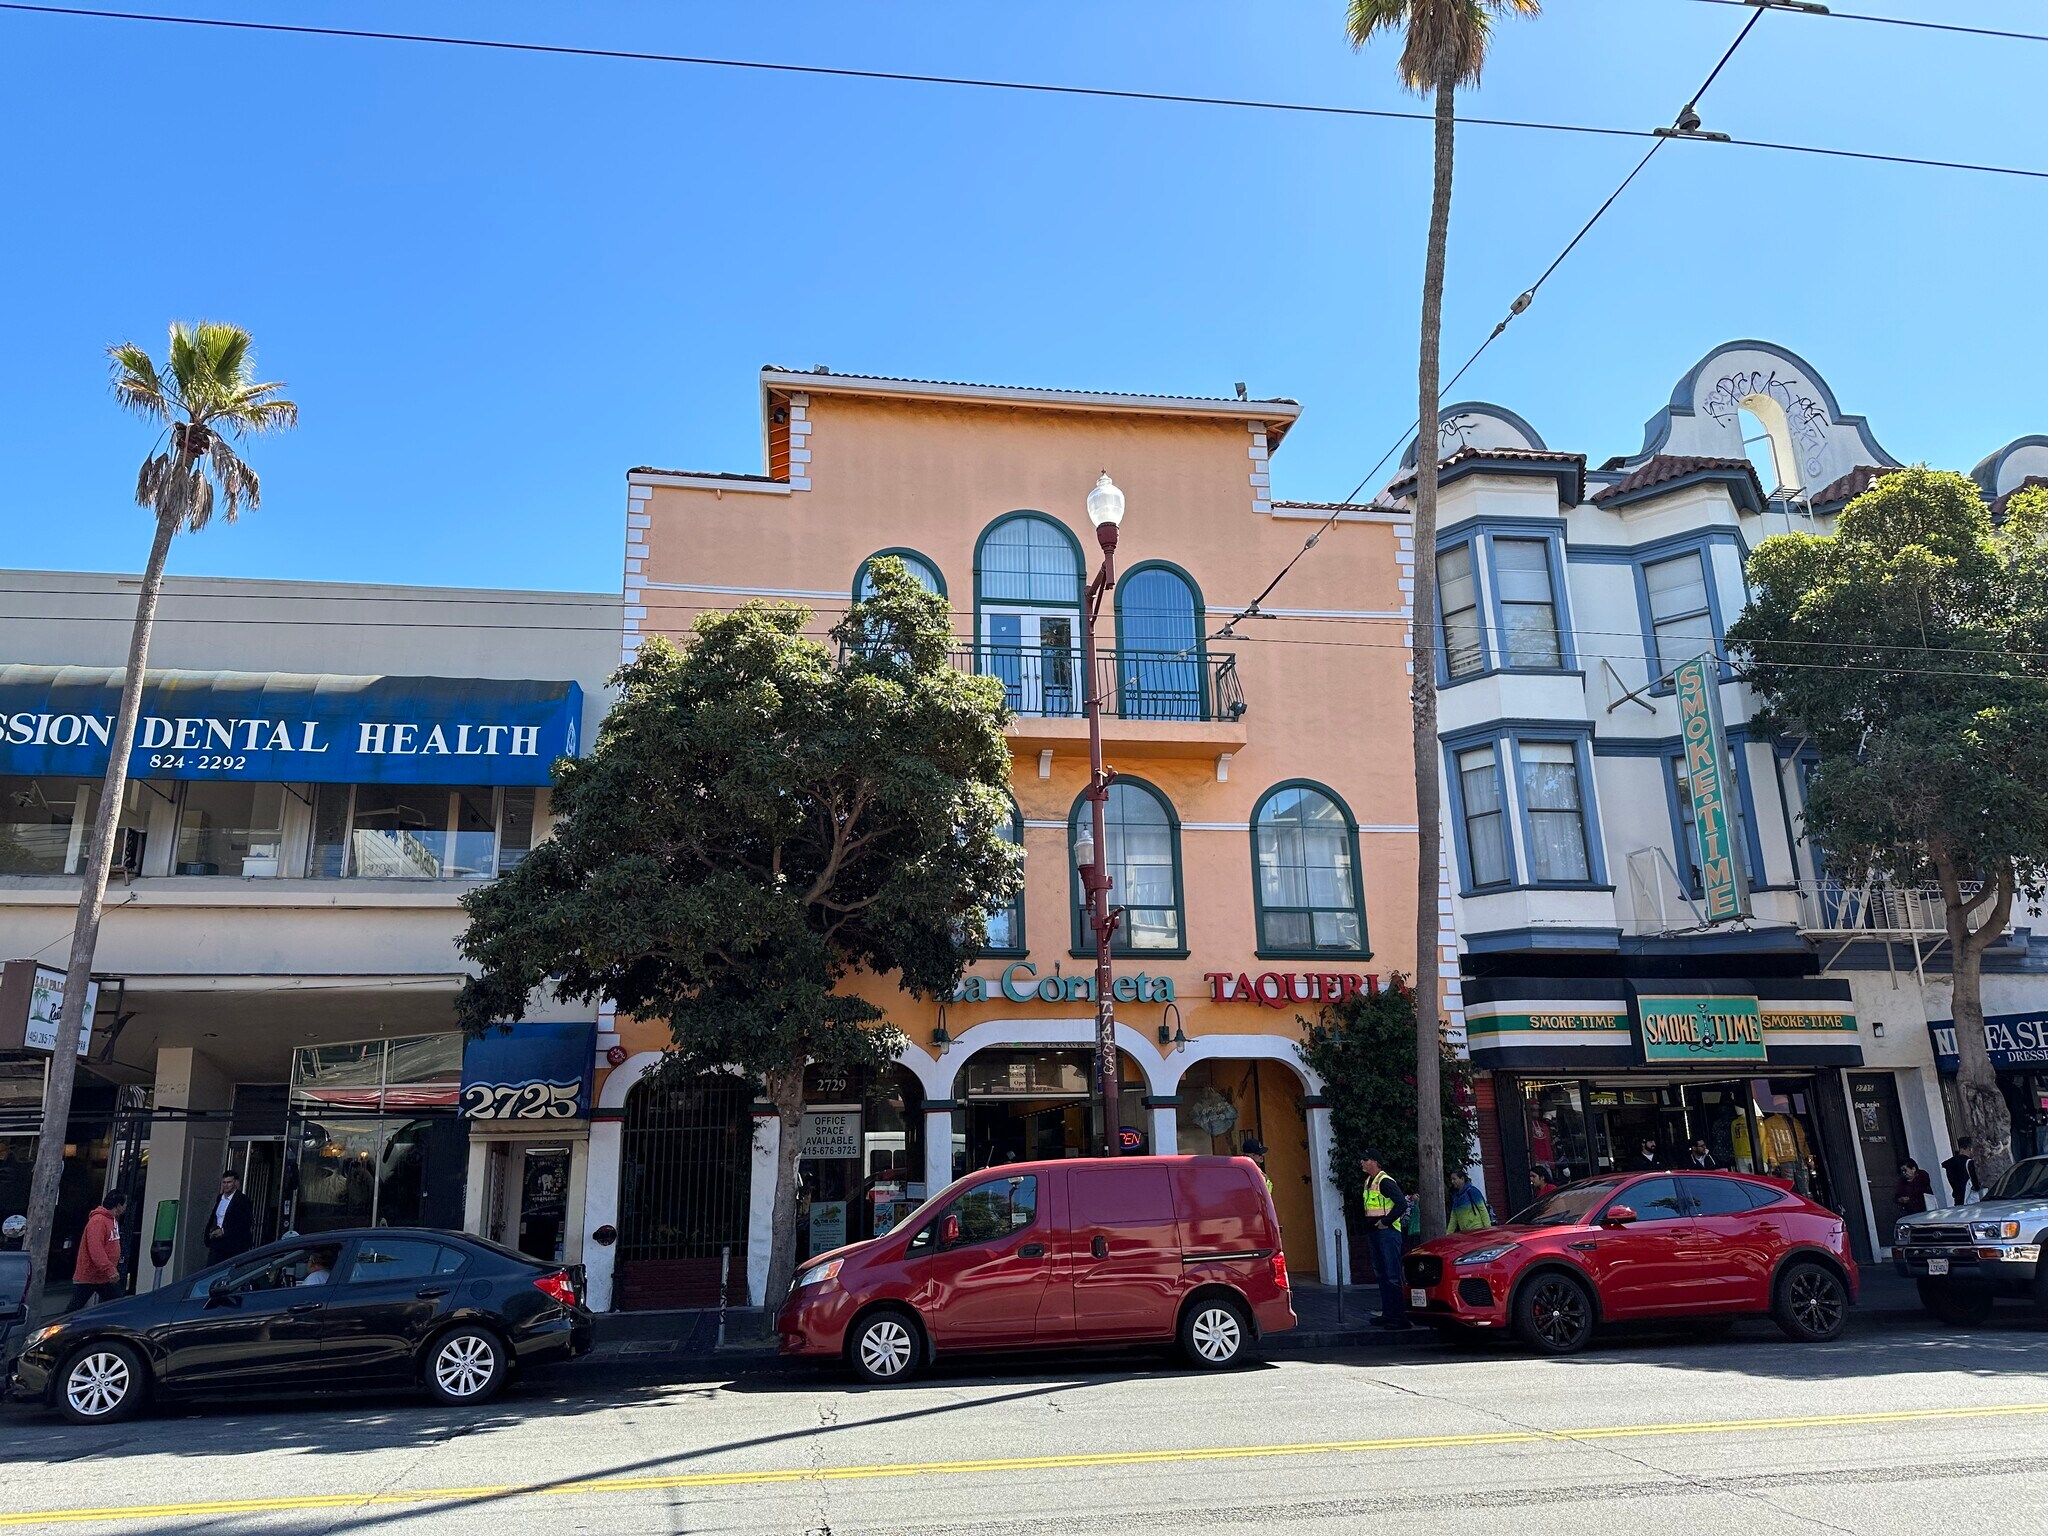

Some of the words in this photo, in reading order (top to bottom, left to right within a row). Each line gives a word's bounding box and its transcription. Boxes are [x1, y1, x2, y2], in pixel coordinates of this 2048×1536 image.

[0, 712, 115, 747] SION
[138, 716, 329, 752] DENTAL
[355, 722, 541, 756] HEALTH
[1645, 1013, 1699, 1045] SMOKE
[1707, 1013, 1762, 1044] TIME
[816, 1078, 847, 1092] 2729
[465, 1082, 580, 1119] 2725
[814, 1116, 846, 1126] OFFICE
[815, 1126, 844, 1136] SPACE
[805, 1136, 854, 1146] AVAILABLE
[1119, 1132, 1141, 1145] PEN
[802, 1146, 857, 1156] 415-676-9725
